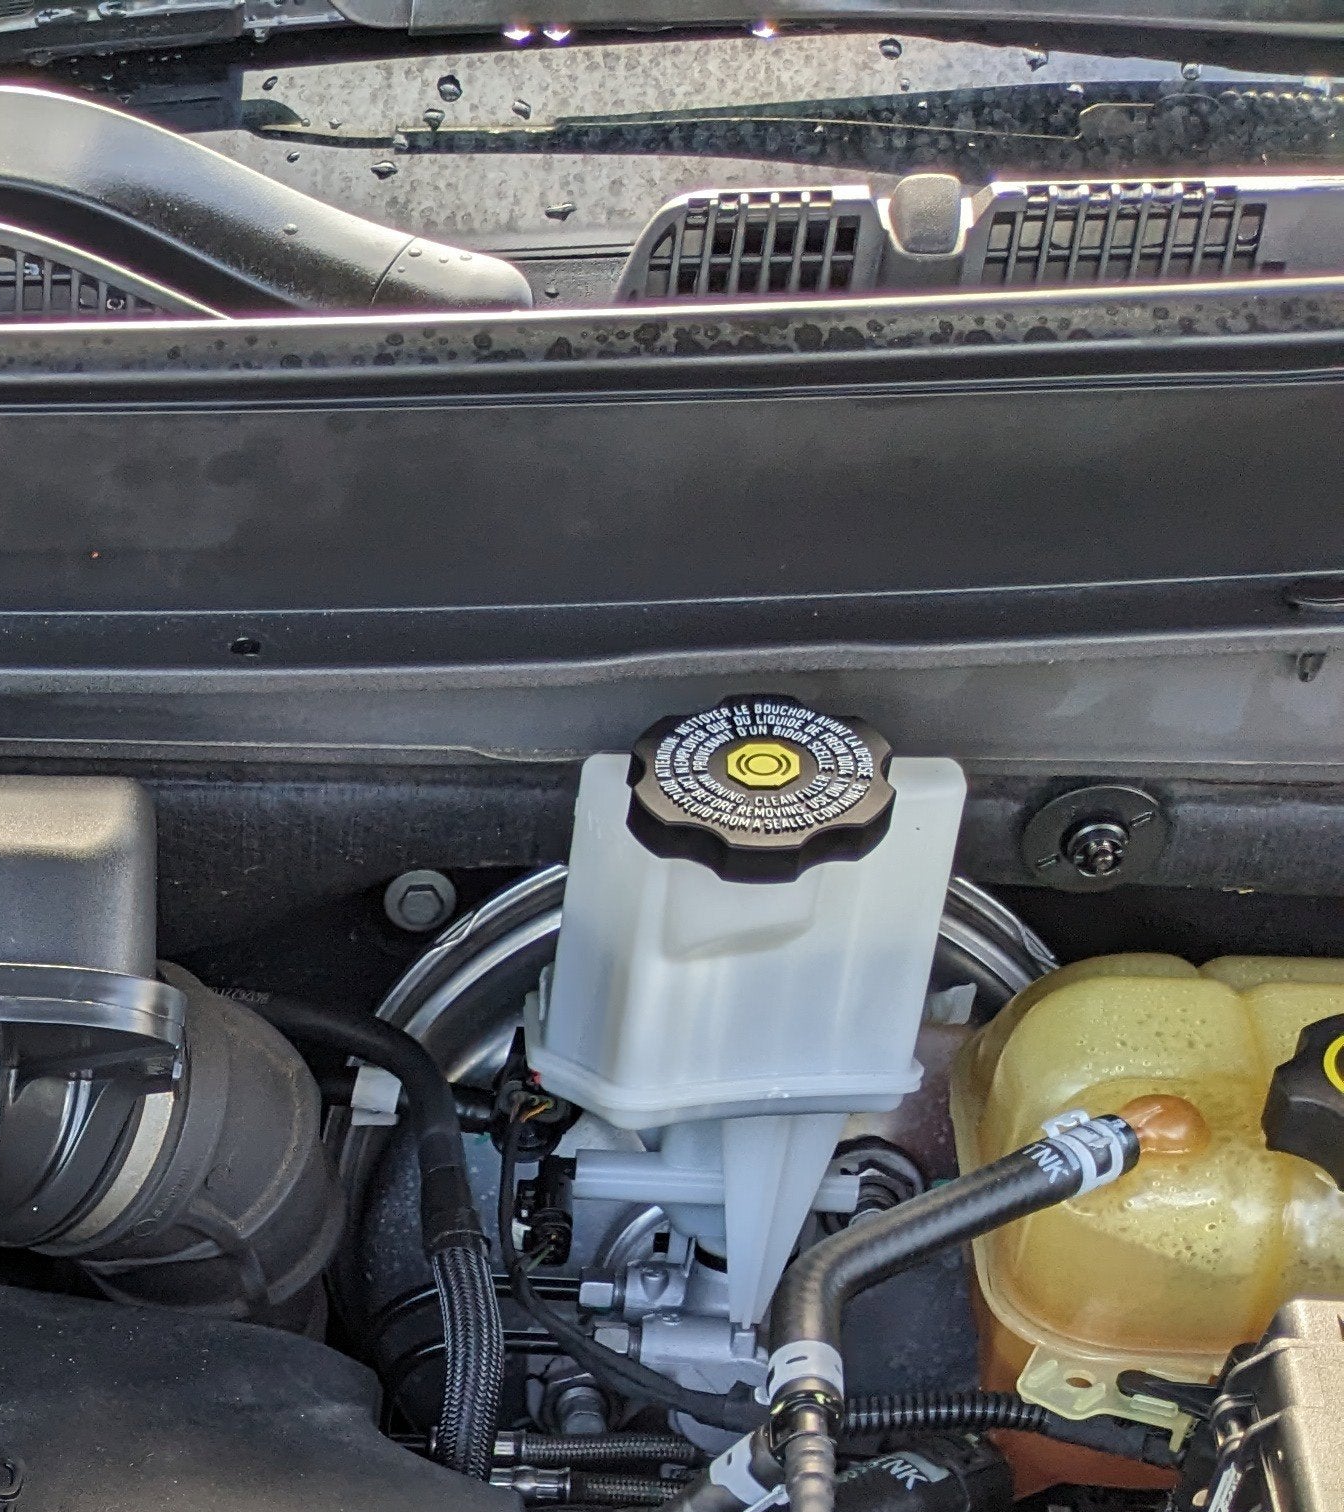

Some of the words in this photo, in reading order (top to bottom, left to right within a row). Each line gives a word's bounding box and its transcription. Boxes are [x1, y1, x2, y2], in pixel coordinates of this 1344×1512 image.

[674, 707, 732, 736] NETTOYER
[733, 704, 750, 715] LE
[754, 703, 815, 721] BOUCHON
[814, 715, 852, 736] AVANT
[844, 735, 863, 747] LA
[706, 719, 732, 734] QUE
[733, 715, 751, 726] DU
[755, 714, 805, 730] LIQUIDE
[804, 723, 824, 736] DE
[819, 732, 849, 755] FREIN
[693, 729, 734, 771] PROVENANT
[736, 724, 768, 736] D'UN
[772, 725, 811, 744] BIDON
[659, 779, 685, 800] DOT4
[679, 797, 714, 818] FLUID
[712, 812, 751, 828] FROM
[752, 819, 761, 828] A
[765, 814, 815, 830] SEALED
[678, 775, 699, 790] CAP
[691, 788, 736, 813] BEFORE
[808, 793, 832, 809] USE
[825, 776, 851, 798] ONLY
[755, 793, 798, 806] CLEAN
[795, 774, 831, 800] FILLER
